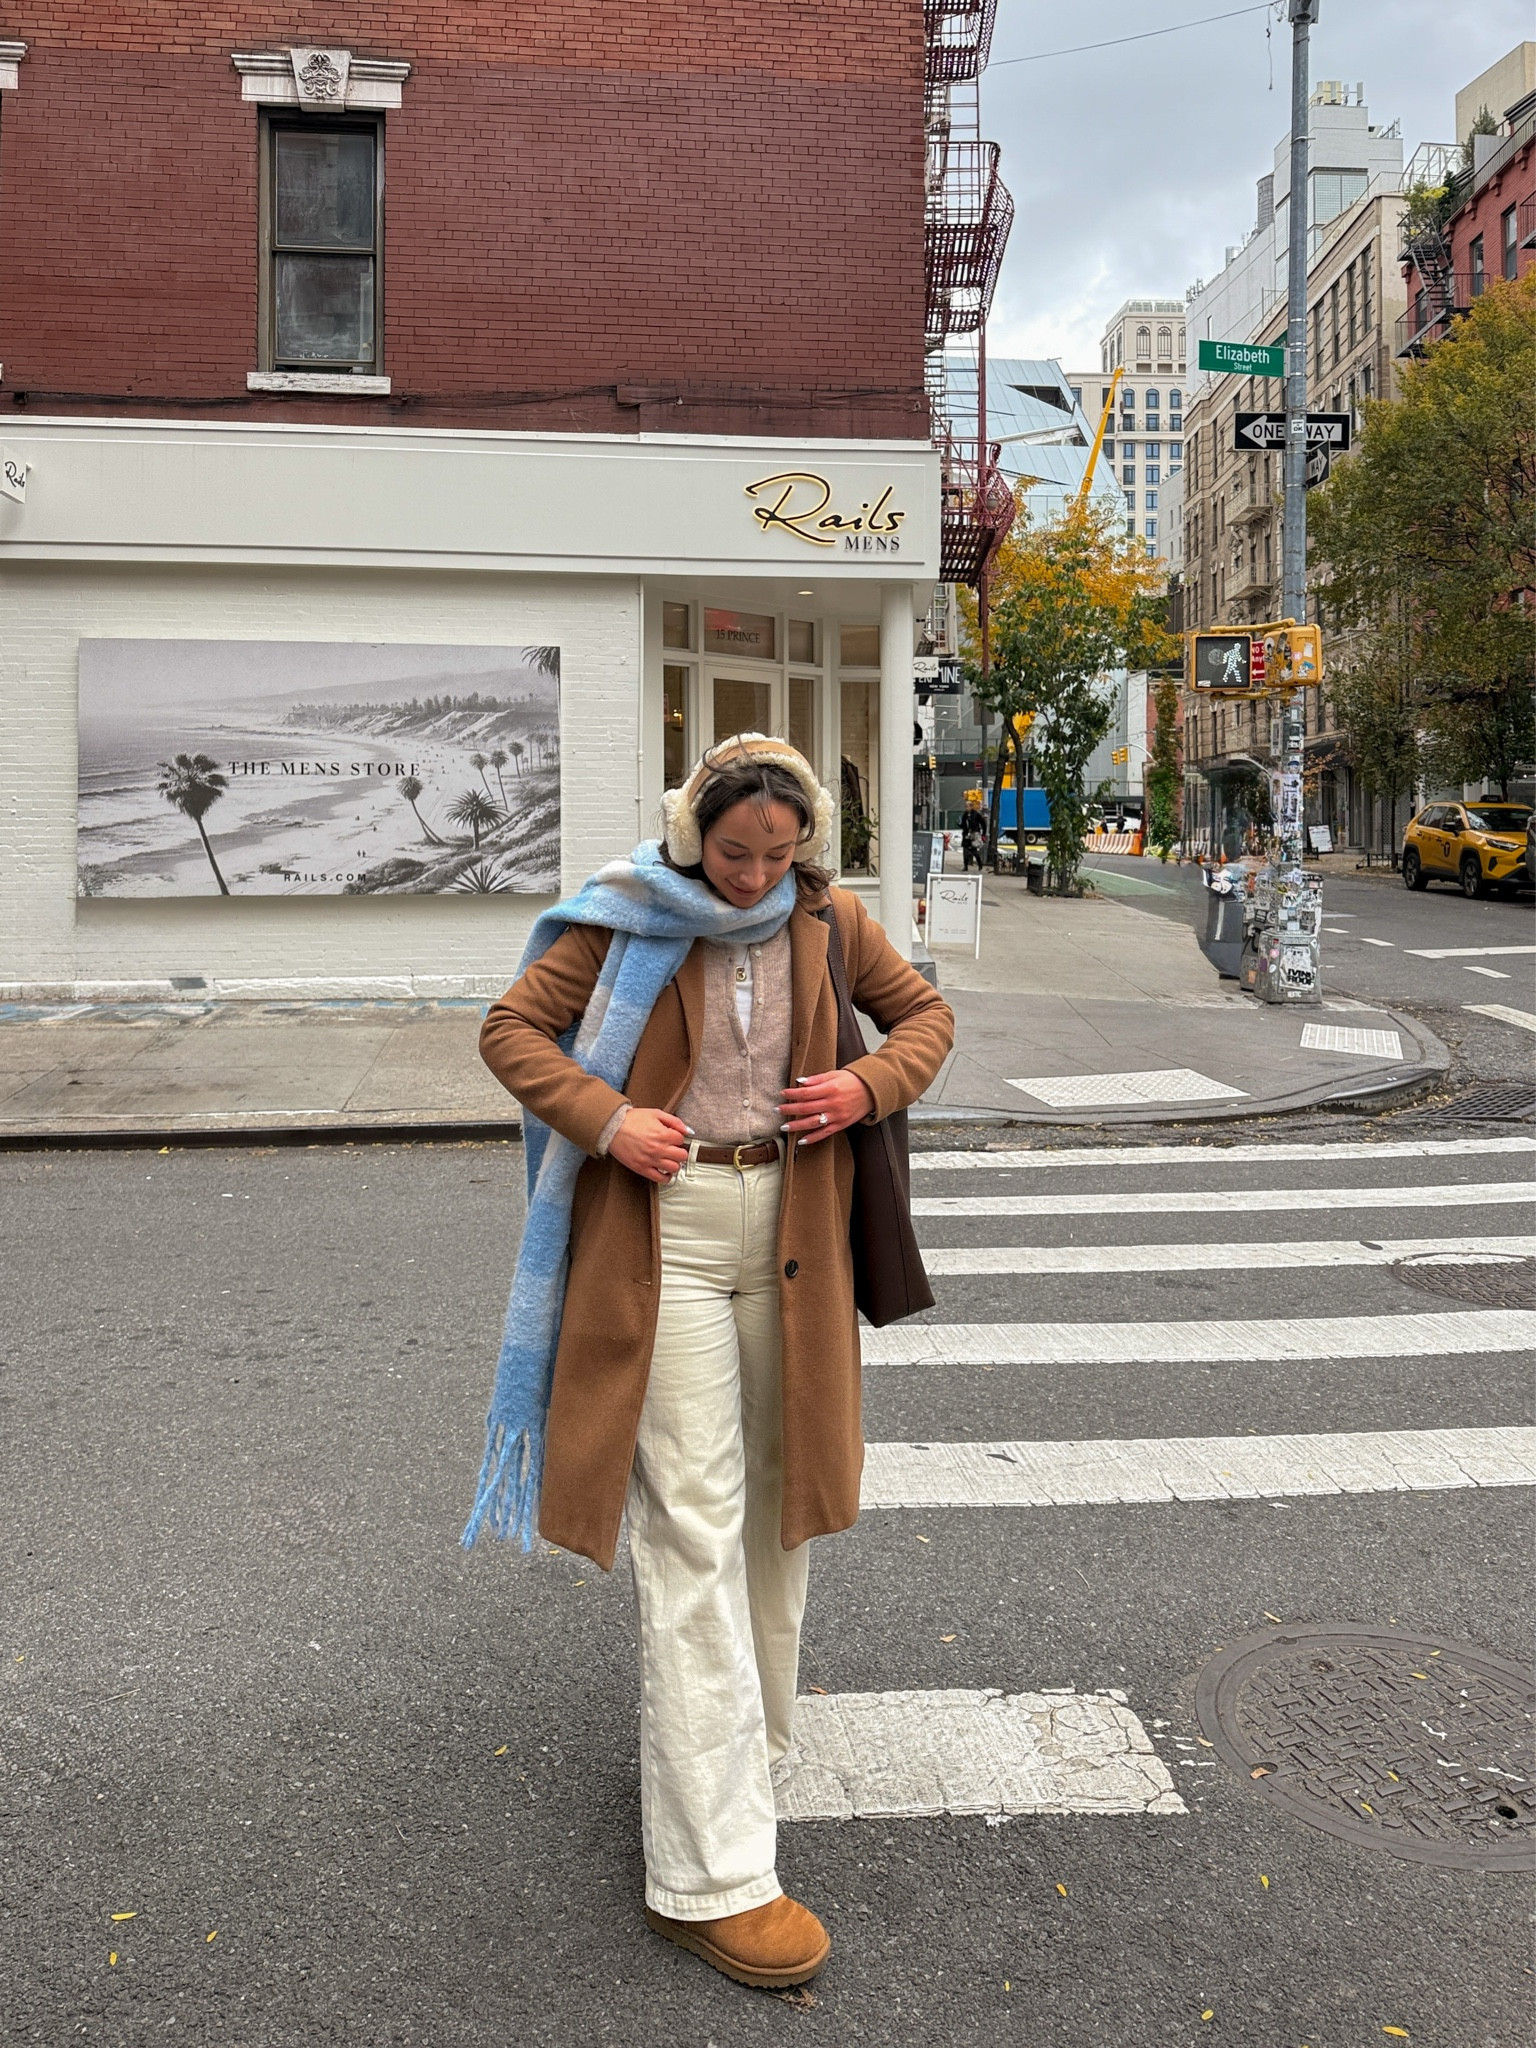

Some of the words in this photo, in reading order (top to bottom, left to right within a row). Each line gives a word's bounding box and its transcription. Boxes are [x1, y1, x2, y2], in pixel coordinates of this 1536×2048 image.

[1215, 344, 1270, 364] Elizabeth
[1233, 362, 1252, 371] Street
[1252, 424, 1285, 439] ONE
[4, 460, 26, 488] Rails
[745, 472, 905, 544] Rails
[845, 535, 900, 551] MENS
[716, 629, 726, 640] 15
[727, 630, 760, 644] PRINCE
[913, 662, 937, 673] Rails
[228, 761, 271, 775] THE
[280, 762, 340, 776] MENS
[350, 762, 421, 777] STORE
[283, 873, 367, 882] RAILS.COM
[940, 890, 968, 904] Rails
